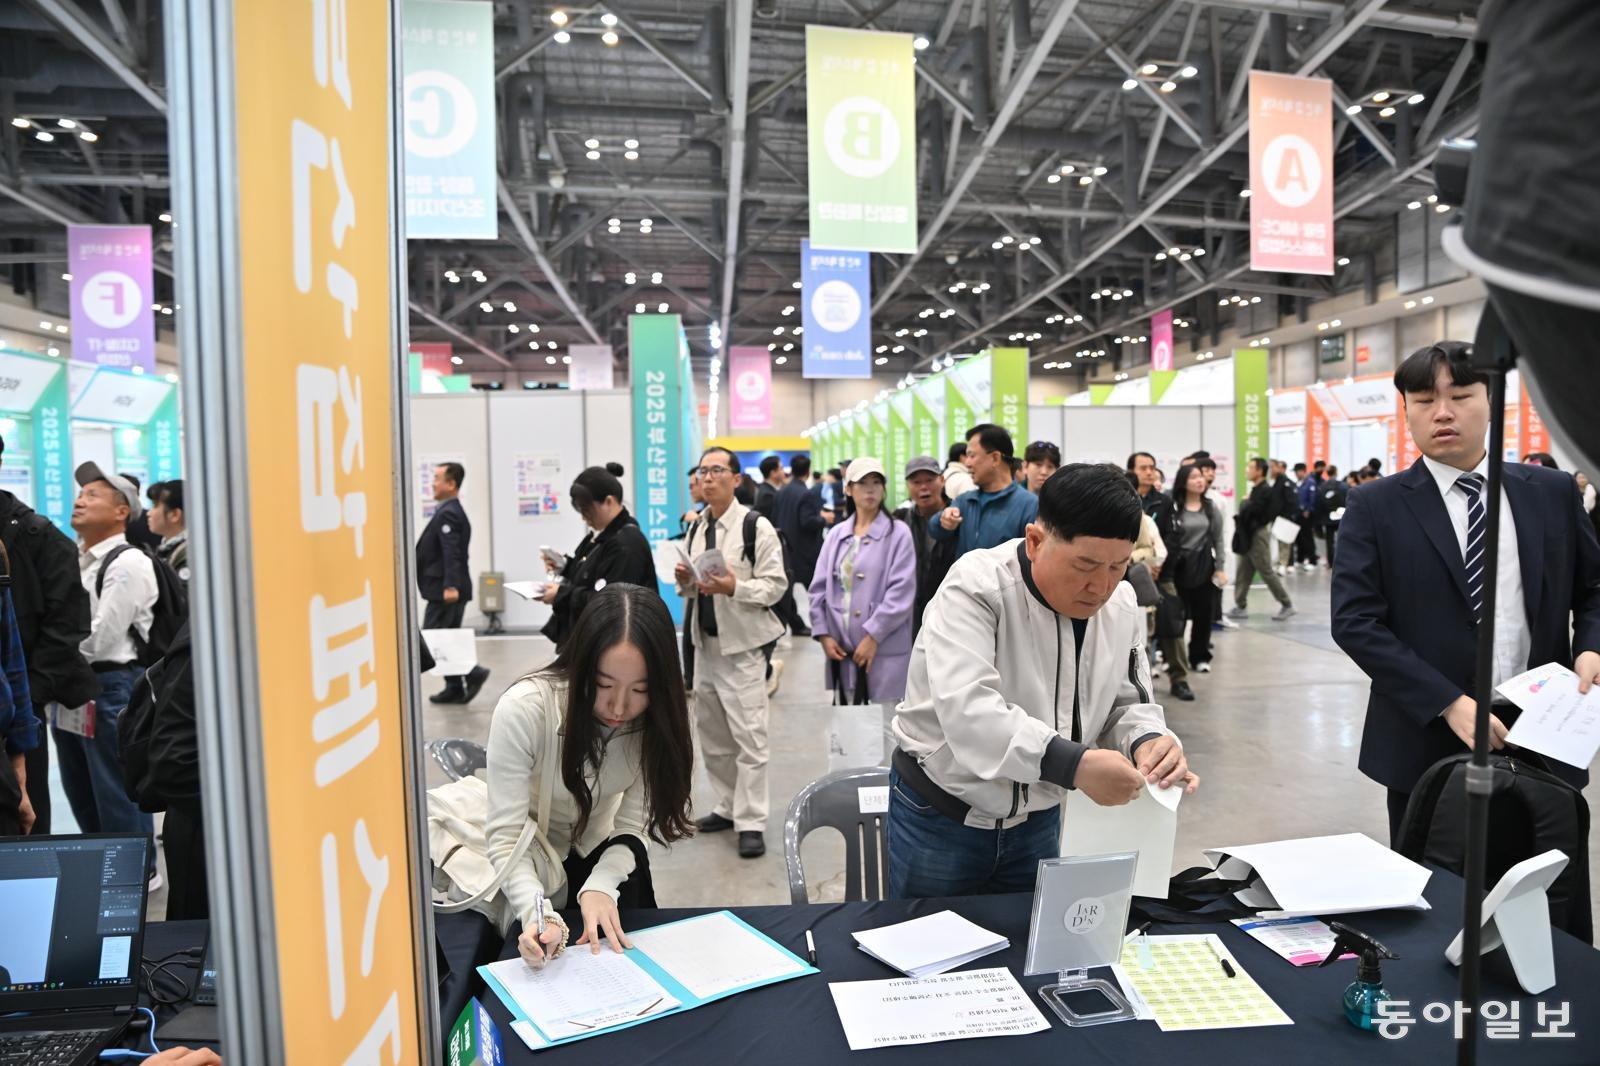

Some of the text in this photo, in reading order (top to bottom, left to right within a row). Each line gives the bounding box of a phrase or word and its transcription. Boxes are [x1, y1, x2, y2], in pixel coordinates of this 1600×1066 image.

[646, 370, 665, 424] 2025
[1245, 394, 1259, 433] 2025
[42, 407, 59, 450] 2025
